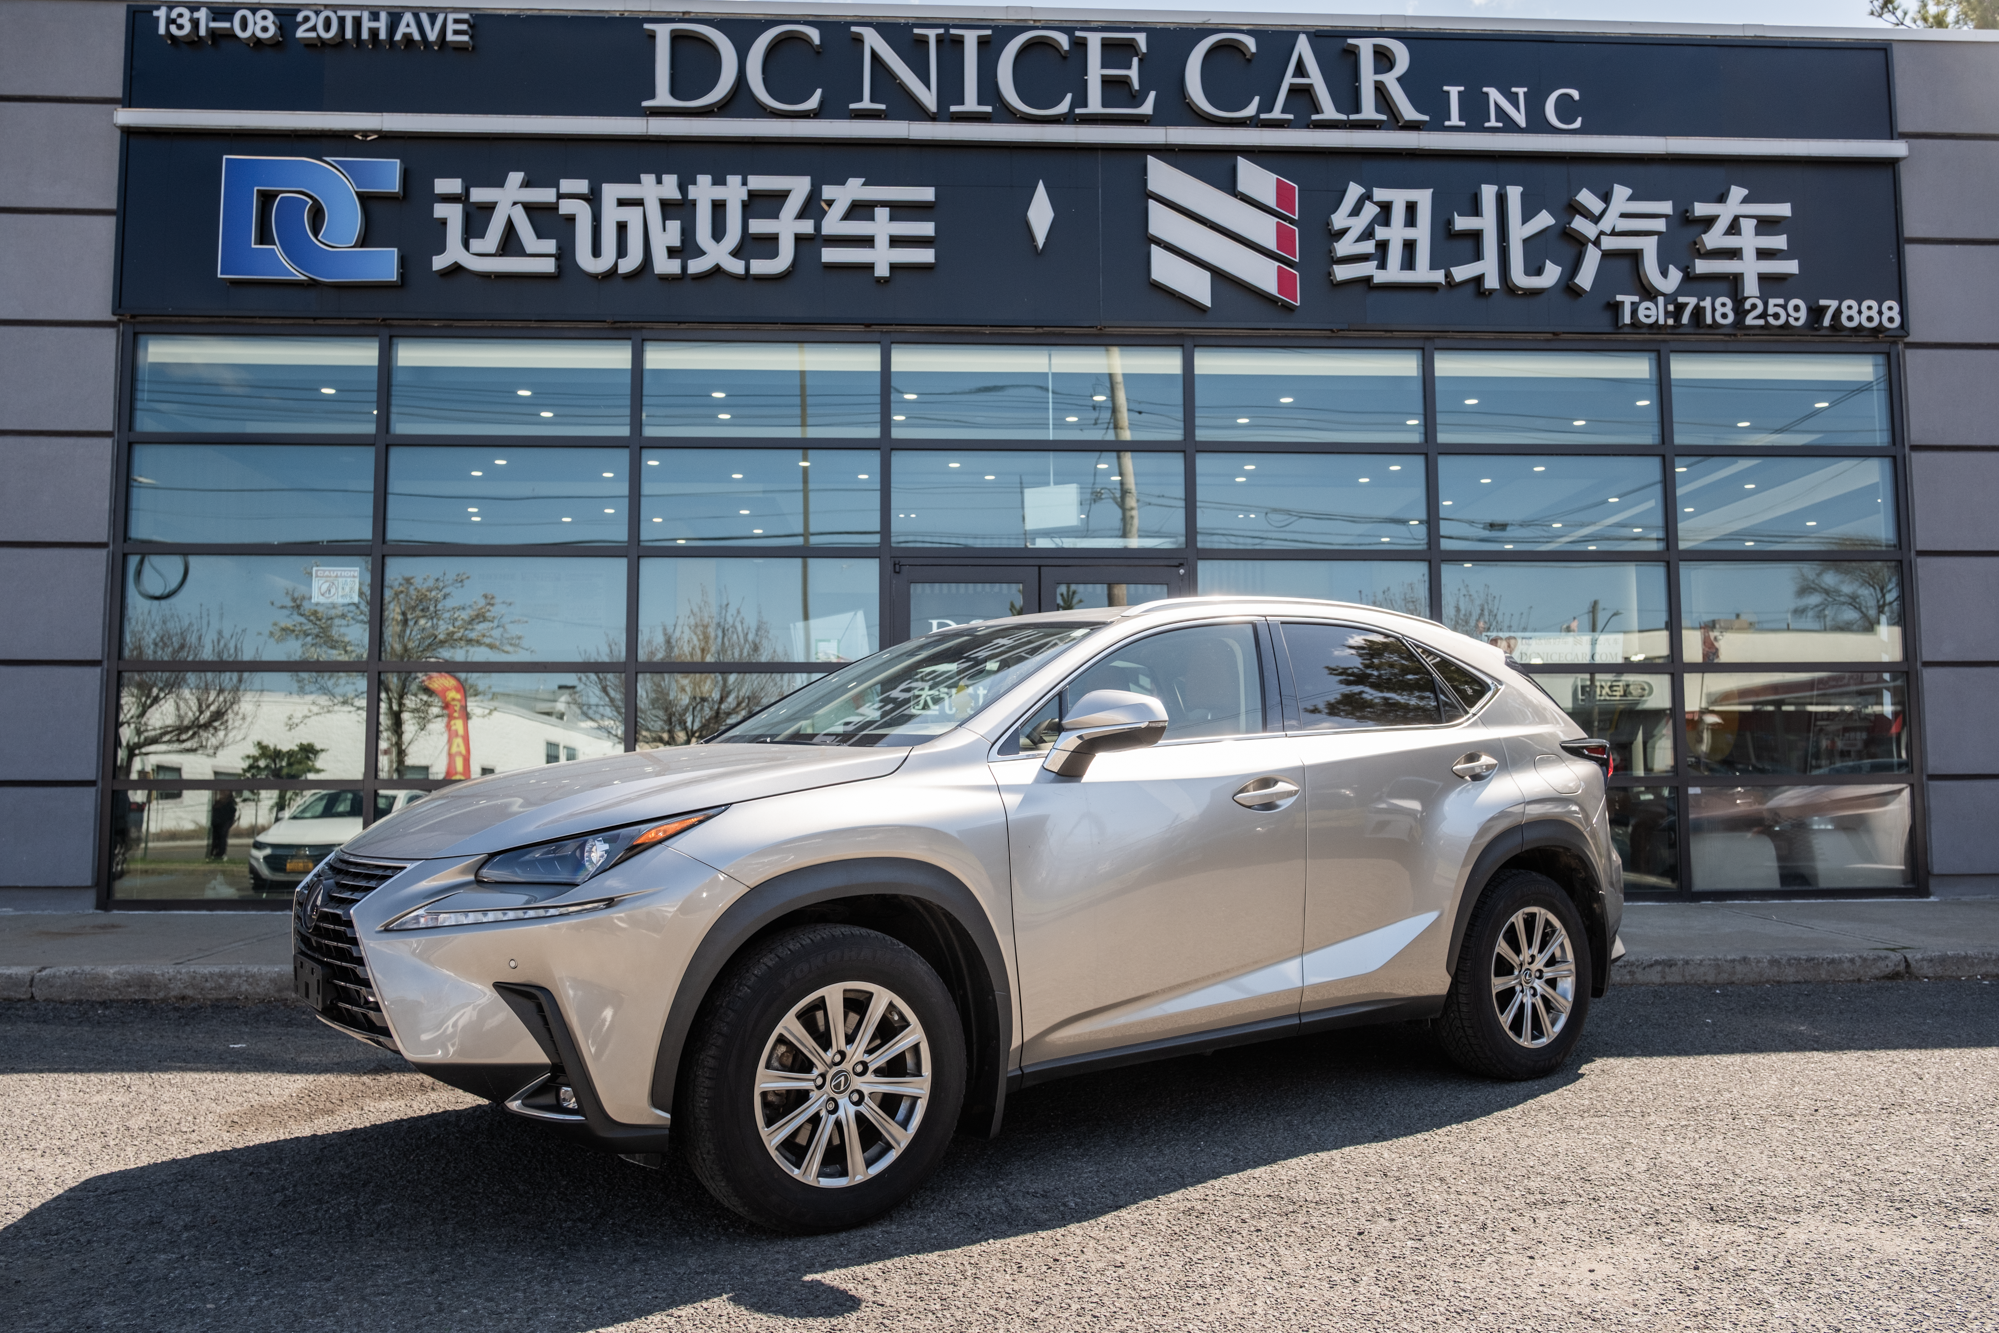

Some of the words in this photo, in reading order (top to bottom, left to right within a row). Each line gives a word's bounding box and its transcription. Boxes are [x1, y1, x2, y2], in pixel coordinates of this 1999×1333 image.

[153, 6, 276, 40] 131-08
[295, 10, 390, 40] 20TH
[393, 12, 472, 42] AVE
[641, 22, 822, 116] DC
[849, 26, 1156, 121] NICE
[1184, 32, 1430, 126] CAR
[1443, 85, 1583, 130] INC
[217, 155, 402, 283] DC
[431, 171, 936, 282] 达诚好车
[1329, 181, 1799, 297] 纽北汽车
[1616, 294, 1735, 326] Tel:718
[1744, 297, 1808, 327] 259
[1818, 298, 1900, 329] 7888
[317, 570, 358, 578] CAUTION
